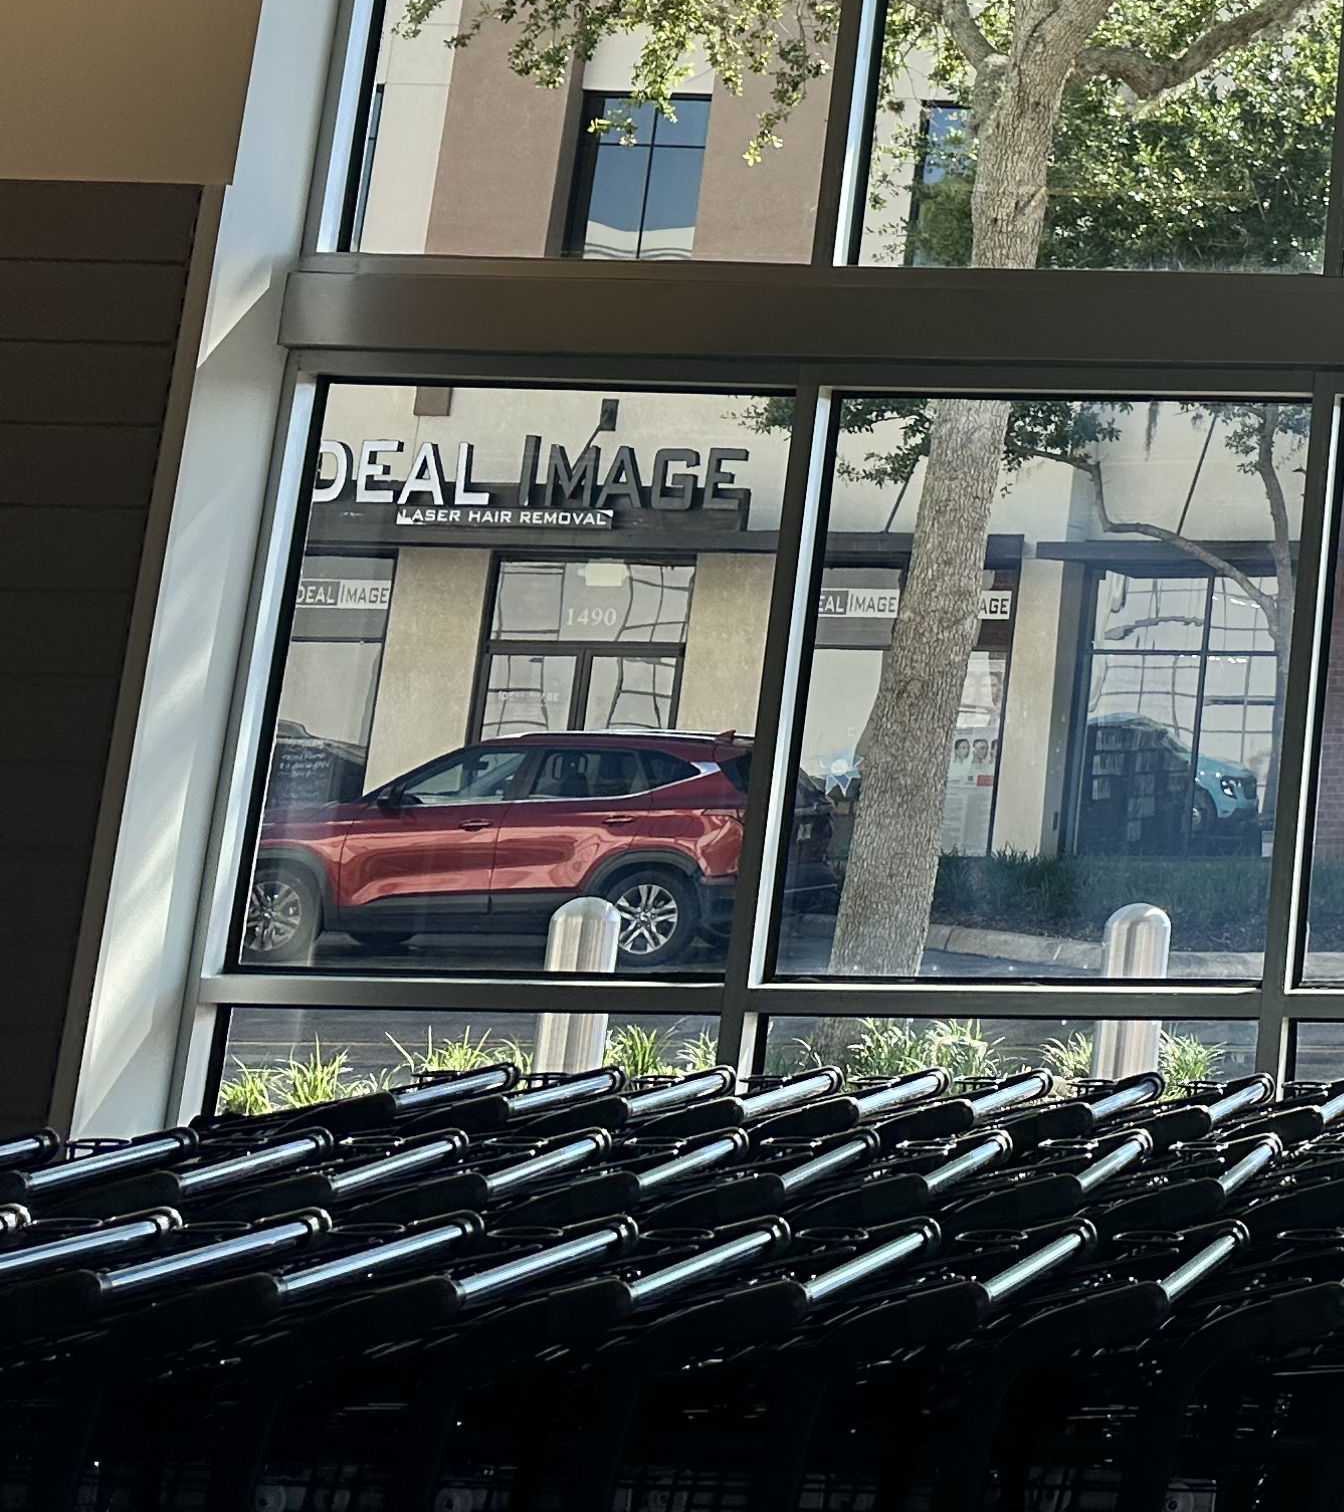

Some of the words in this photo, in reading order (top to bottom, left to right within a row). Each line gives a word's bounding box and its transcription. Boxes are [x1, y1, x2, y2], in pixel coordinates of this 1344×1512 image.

[519, 434, 751, 510] IMAGE
[396, 508, 461, 525] LASER
[468, 510, 511, 523] HAIR
[519, 511, 607, 526] REMOVAL
[340, 584, 390, 604] IMAGE
[849, 594, 897, 613] IMAGE
[565, 608, 618, 627] 1490
